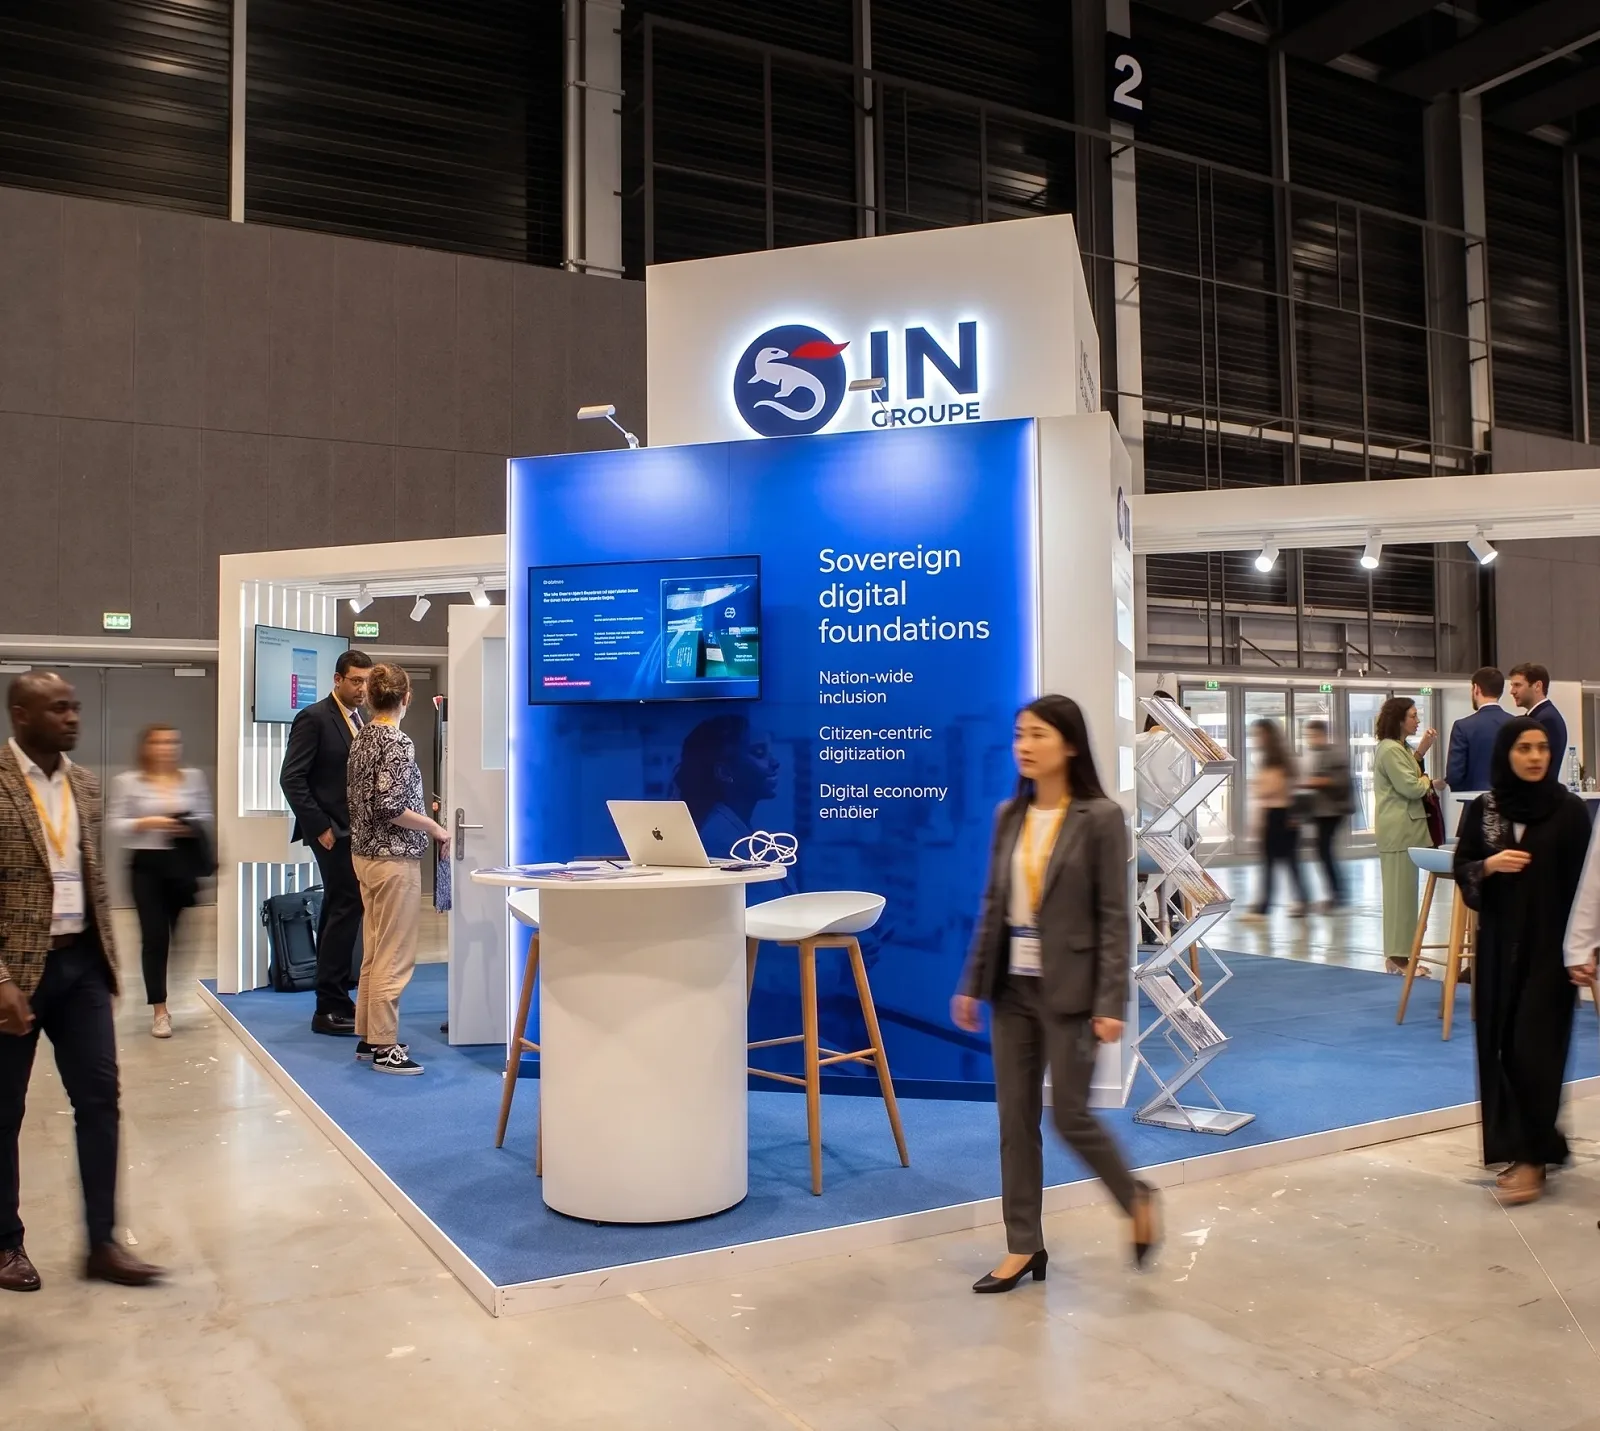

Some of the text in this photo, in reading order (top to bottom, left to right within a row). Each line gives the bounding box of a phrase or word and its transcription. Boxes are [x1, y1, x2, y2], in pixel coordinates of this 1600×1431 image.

[1113, 54, 1143, 111] 2
[870, 321, 978, 403] IN
[871, 402, 981, 428] GROUPE
[819, 544, 961, 575] Sovereign
[819, 580, 906, 613] digital
[818, 615, 990, 644] foundations
[819, 669, 914, 685] Nation-wide
[819, 690, 887, 704] inclusion
[819, 725, 932, 741] Citizen-centric
[819, 746, 905, 764] digitization
[820, 783, 948, 802] Digital economy
